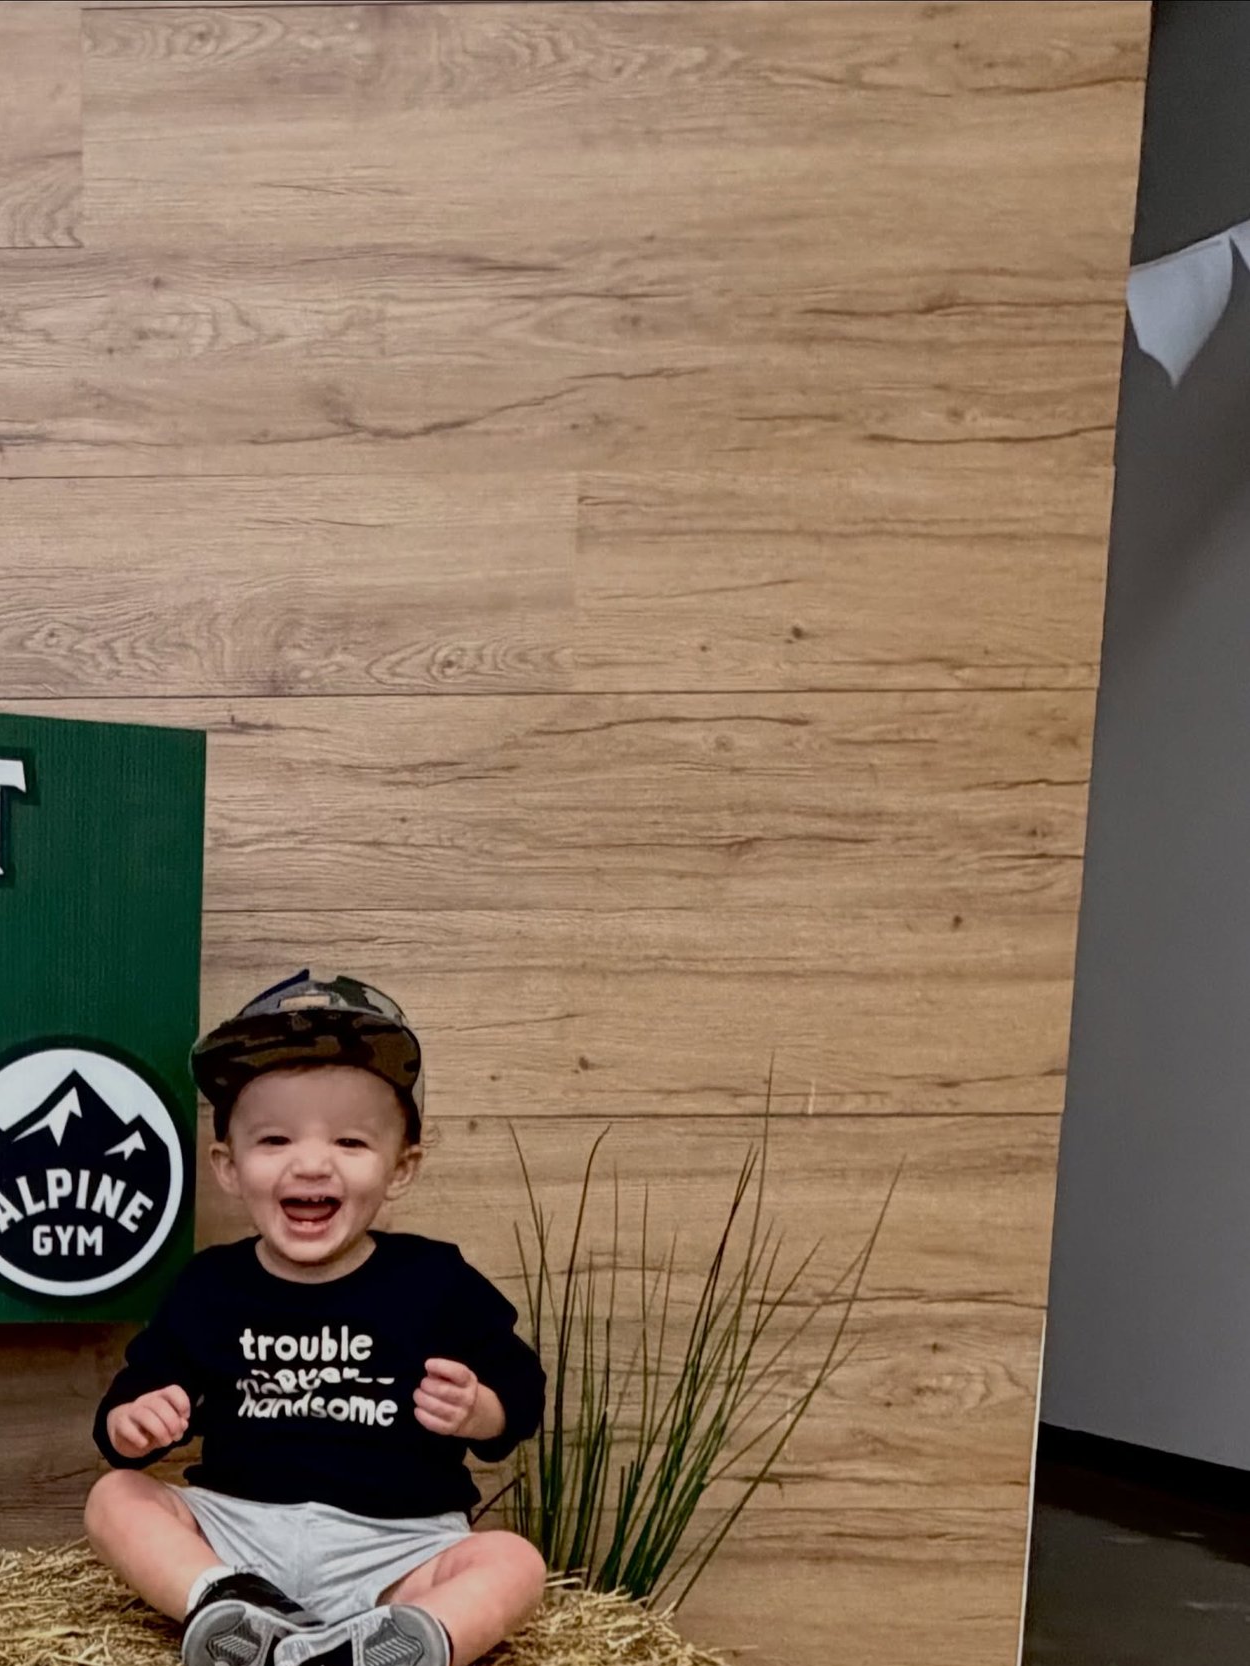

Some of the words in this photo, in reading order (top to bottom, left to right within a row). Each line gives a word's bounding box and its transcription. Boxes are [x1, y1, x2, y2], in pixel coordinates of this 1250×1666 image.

[32, 1224, 103, 1257] GYM
[238, 1324, 374, 1362] trouble
[237, 1384, 399, 1427] handsome
